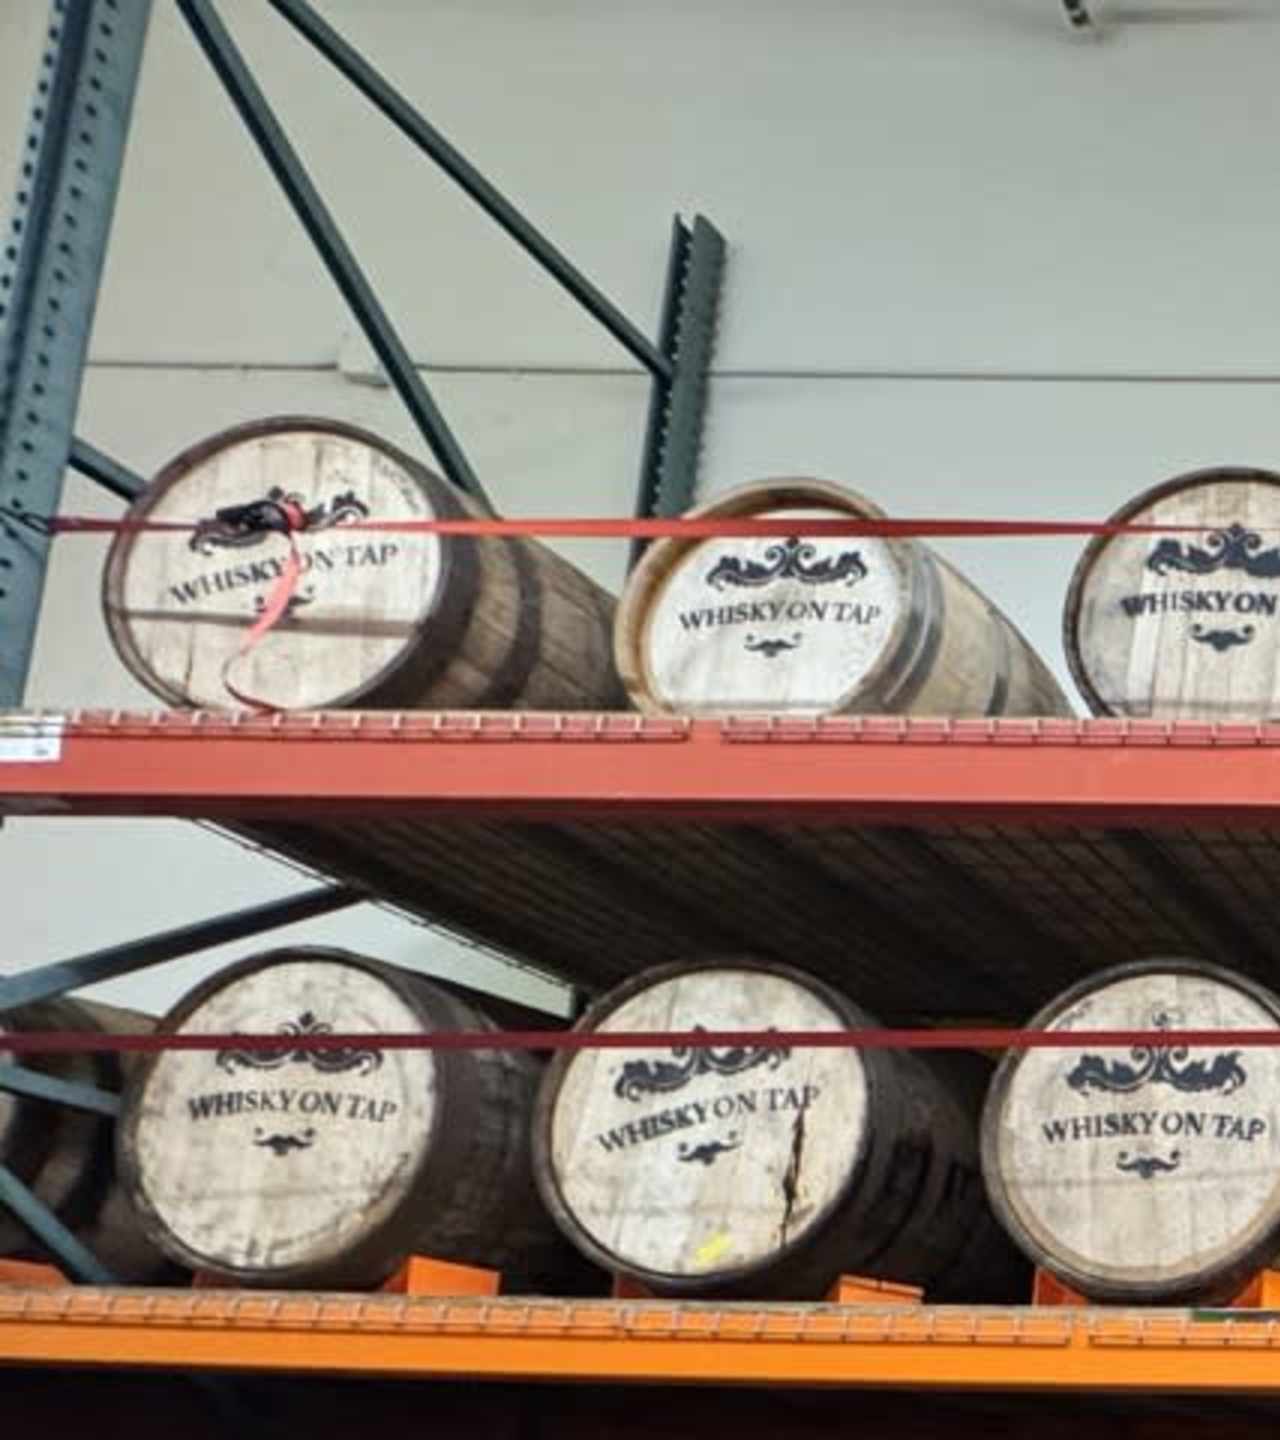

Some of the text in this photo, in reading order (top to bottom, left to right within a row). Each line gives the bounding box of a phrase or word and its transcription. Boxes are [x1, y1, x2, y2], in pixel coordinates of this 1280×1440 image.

[169, 557, 288, 606] WHISKY
[341, 542, 399, 568] TAP
[678, 600, 881, 631] WHISKY ON TAP
[1118, 591, 1233, 617] WHISKY
[1234, 592, 1275, 616] ON
[187, 1089, 398, 1123] WHISKY ON TAP
[598, 1085, 820, 1153] WHISKY ON TAP
[1042, 1110, 1266, 1144] WHISKY ON TAP
